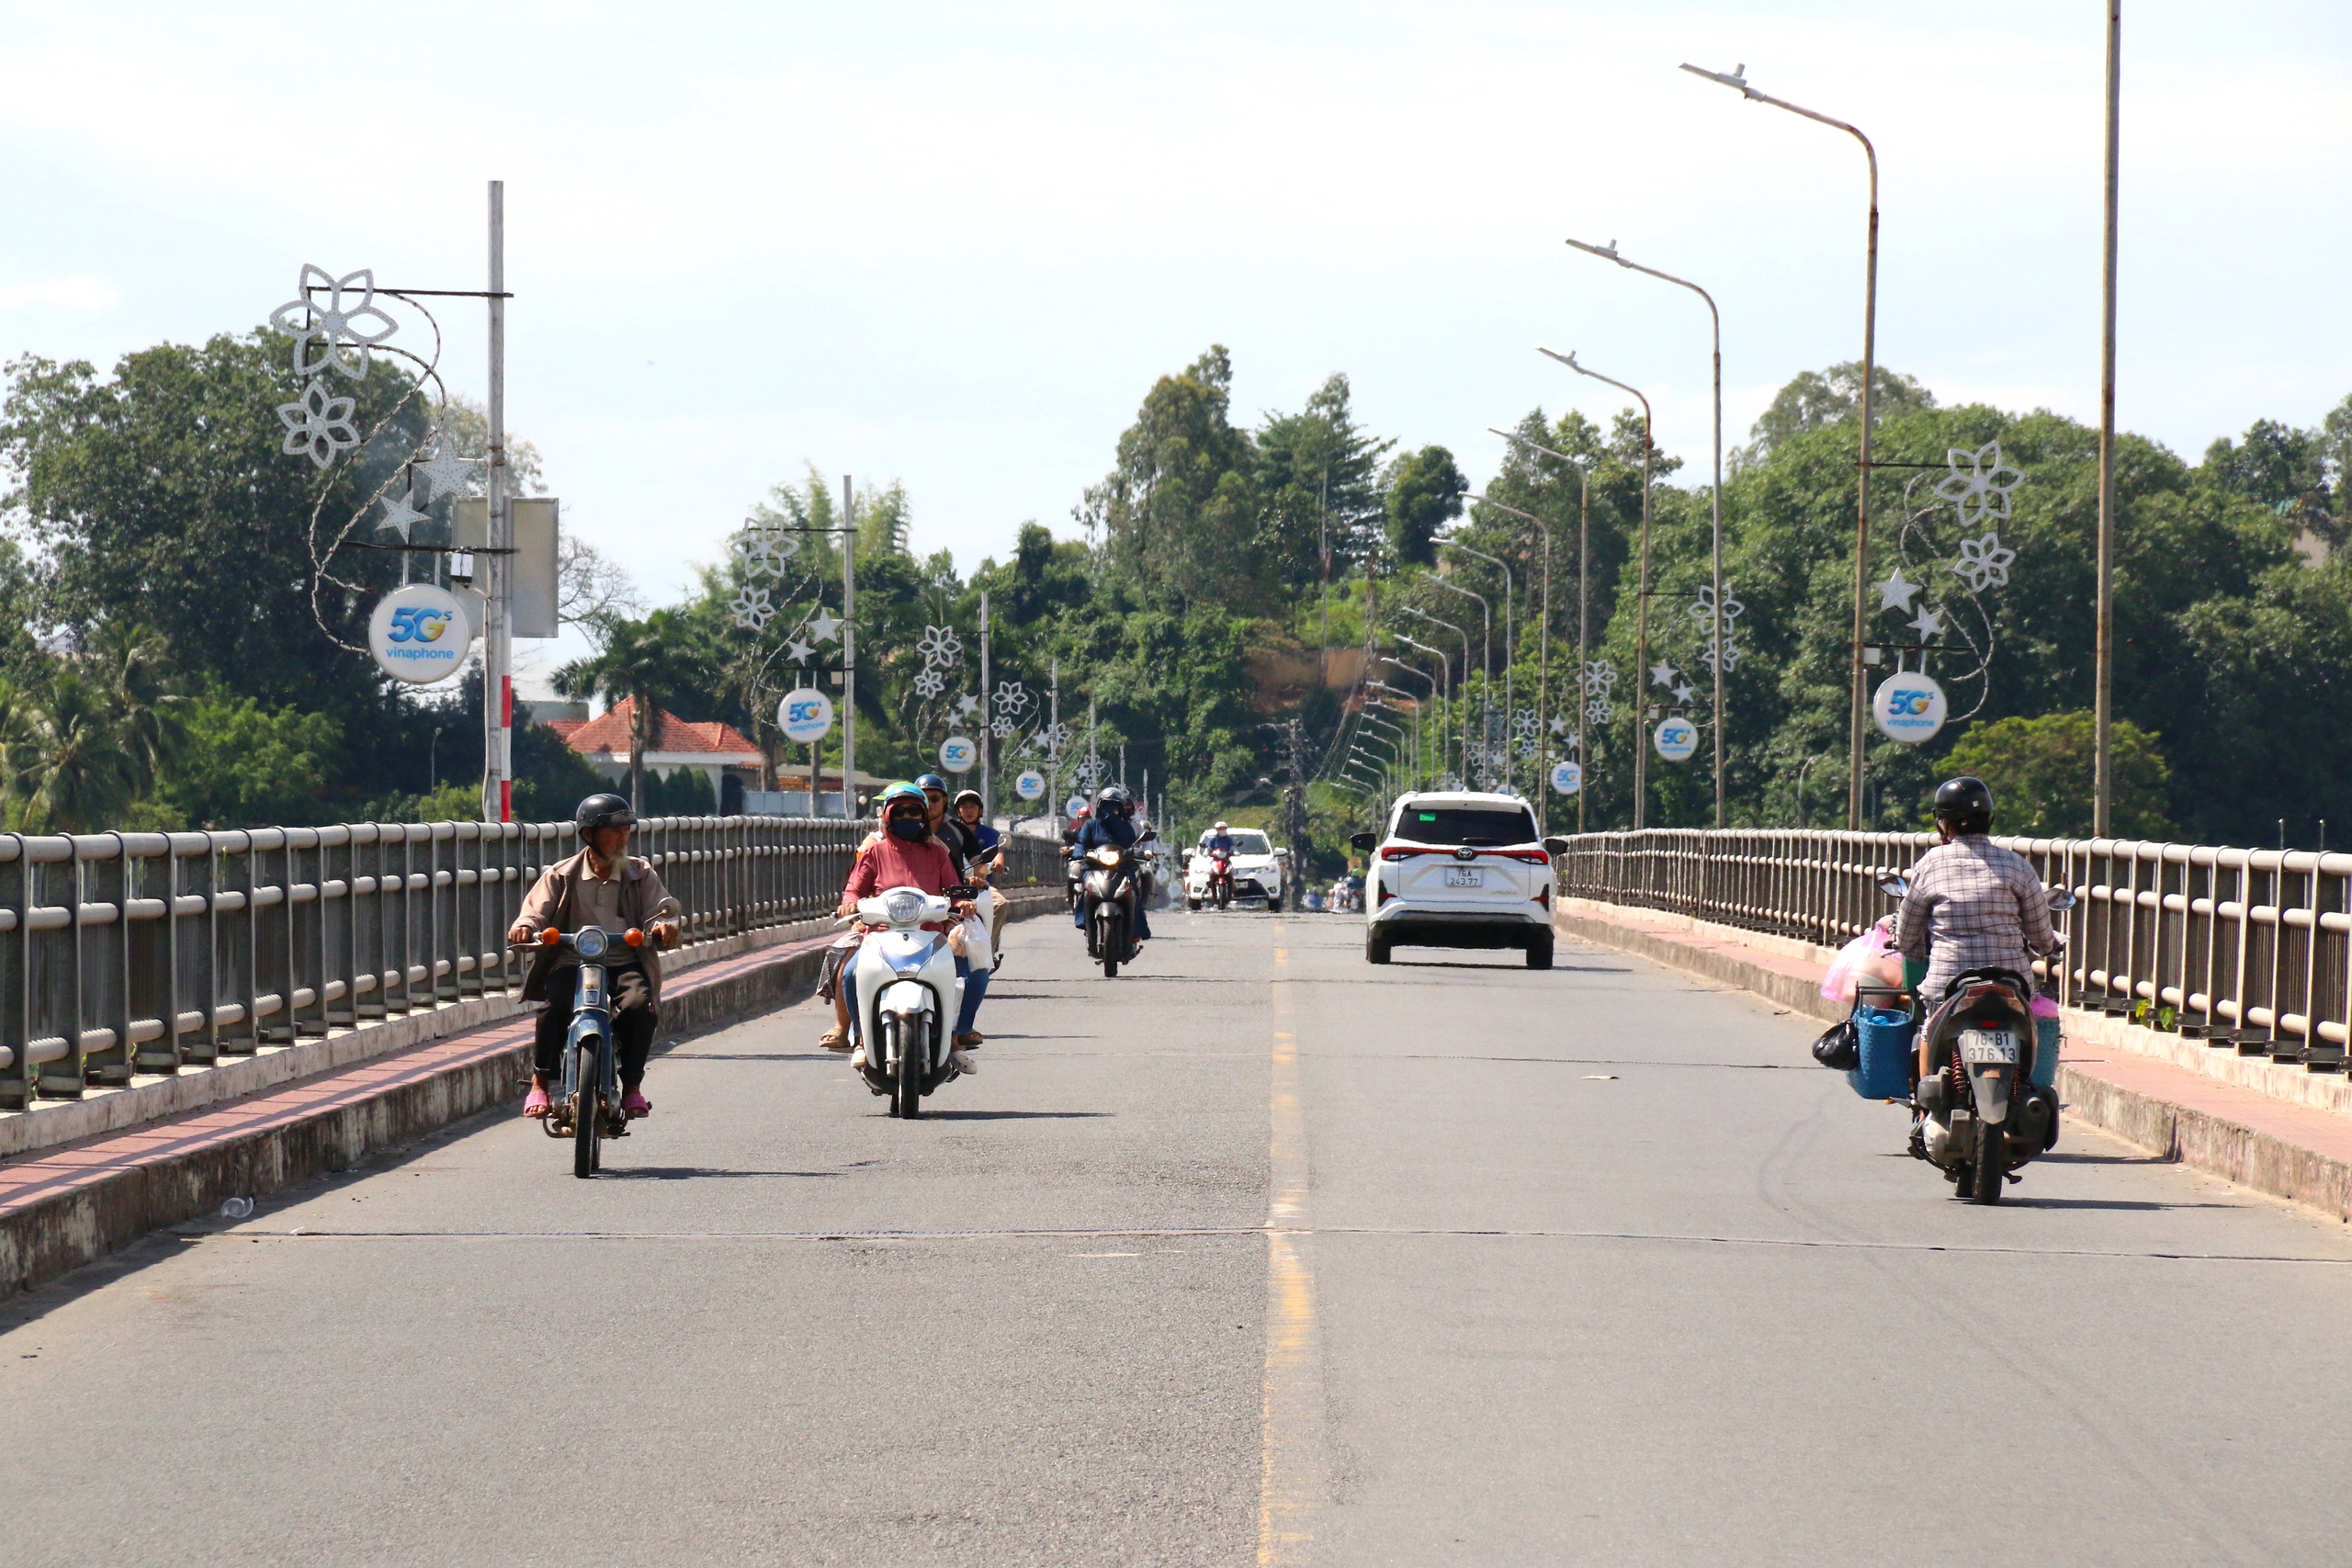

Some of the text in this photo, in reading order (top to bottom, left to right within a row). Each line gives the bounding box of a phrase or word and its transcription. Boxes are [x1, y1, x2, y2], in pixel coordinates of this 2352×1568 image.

[386, 647, 454, 660] vinaphone
[1887, 718, 1936, 728] vinaphone
[1457, 869, 1472, 877] 76A
[1450, 877, 1478, 886] 243.77
[1973, 1032, 2009, 1046] 76-B1
[1968, 1047, 2016, 1061] 376.13
